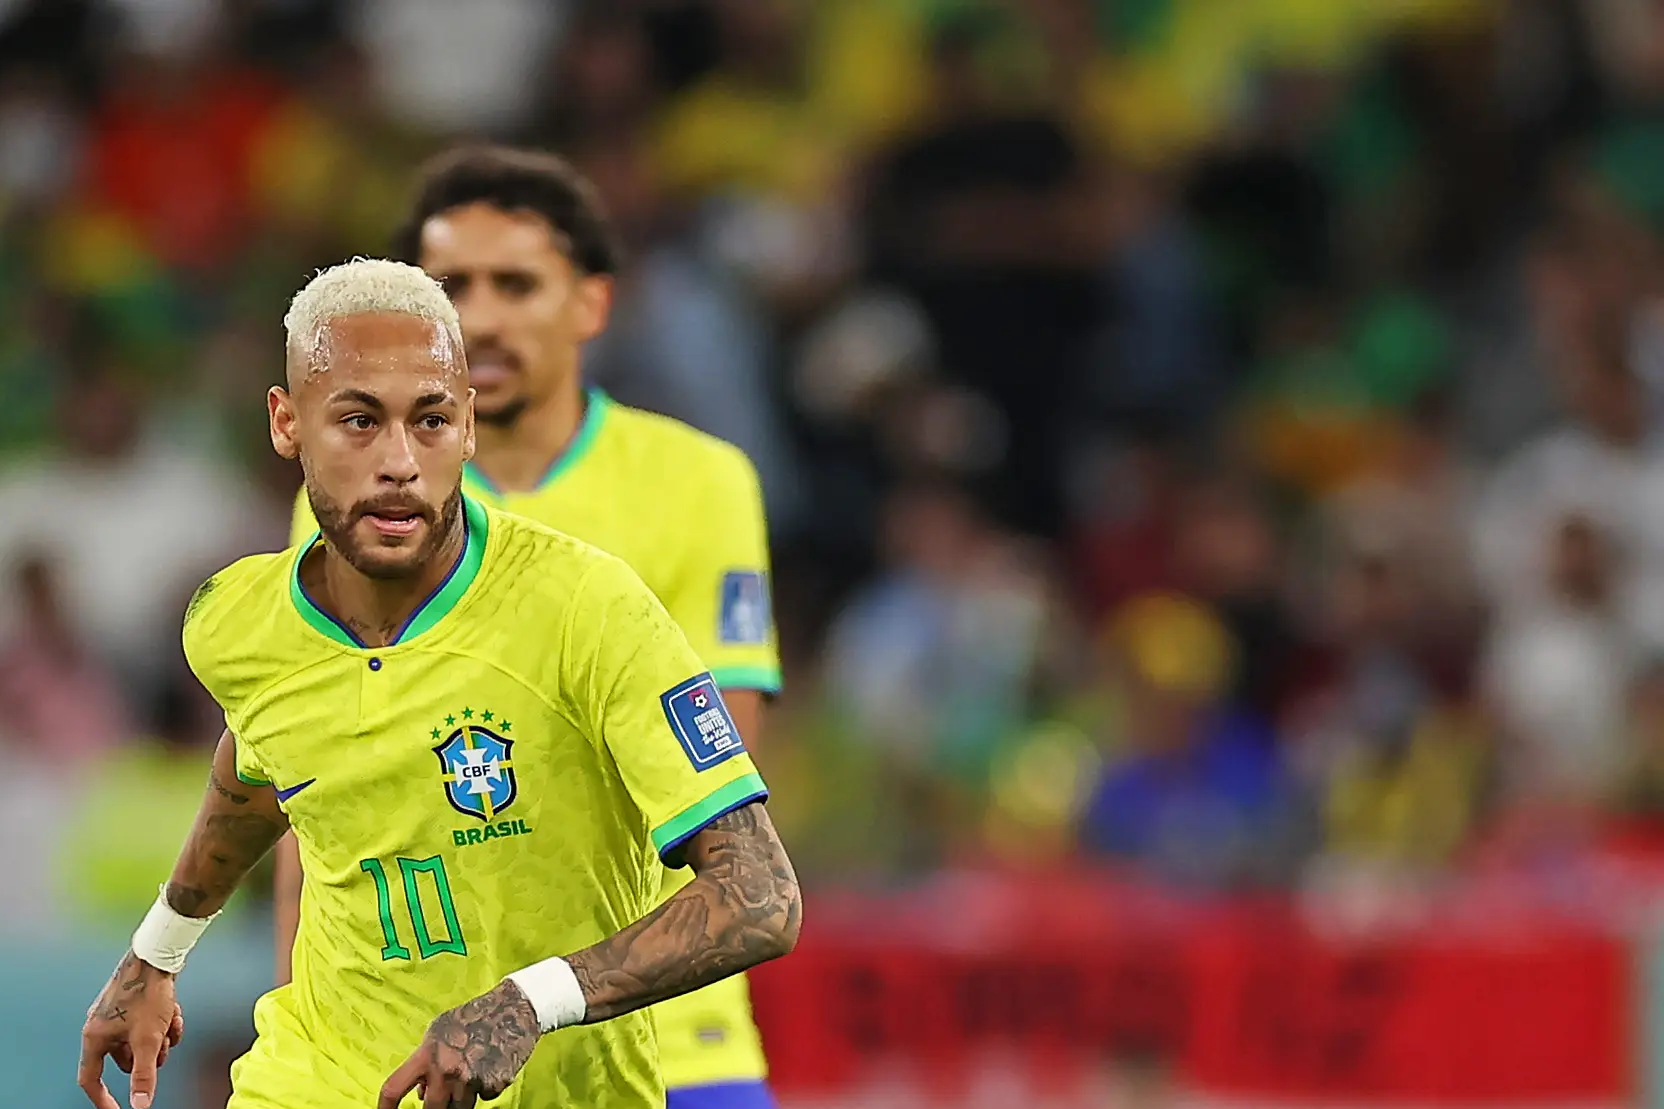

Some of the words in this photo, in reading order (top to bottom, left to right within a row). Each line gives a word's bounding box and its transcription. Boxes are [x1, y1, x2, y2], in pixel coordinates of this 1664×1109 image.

[462, 765, 491, 778] CBF
[452, 819, 533, 846] BRASIL
[360, 855, 467, 961] 10
